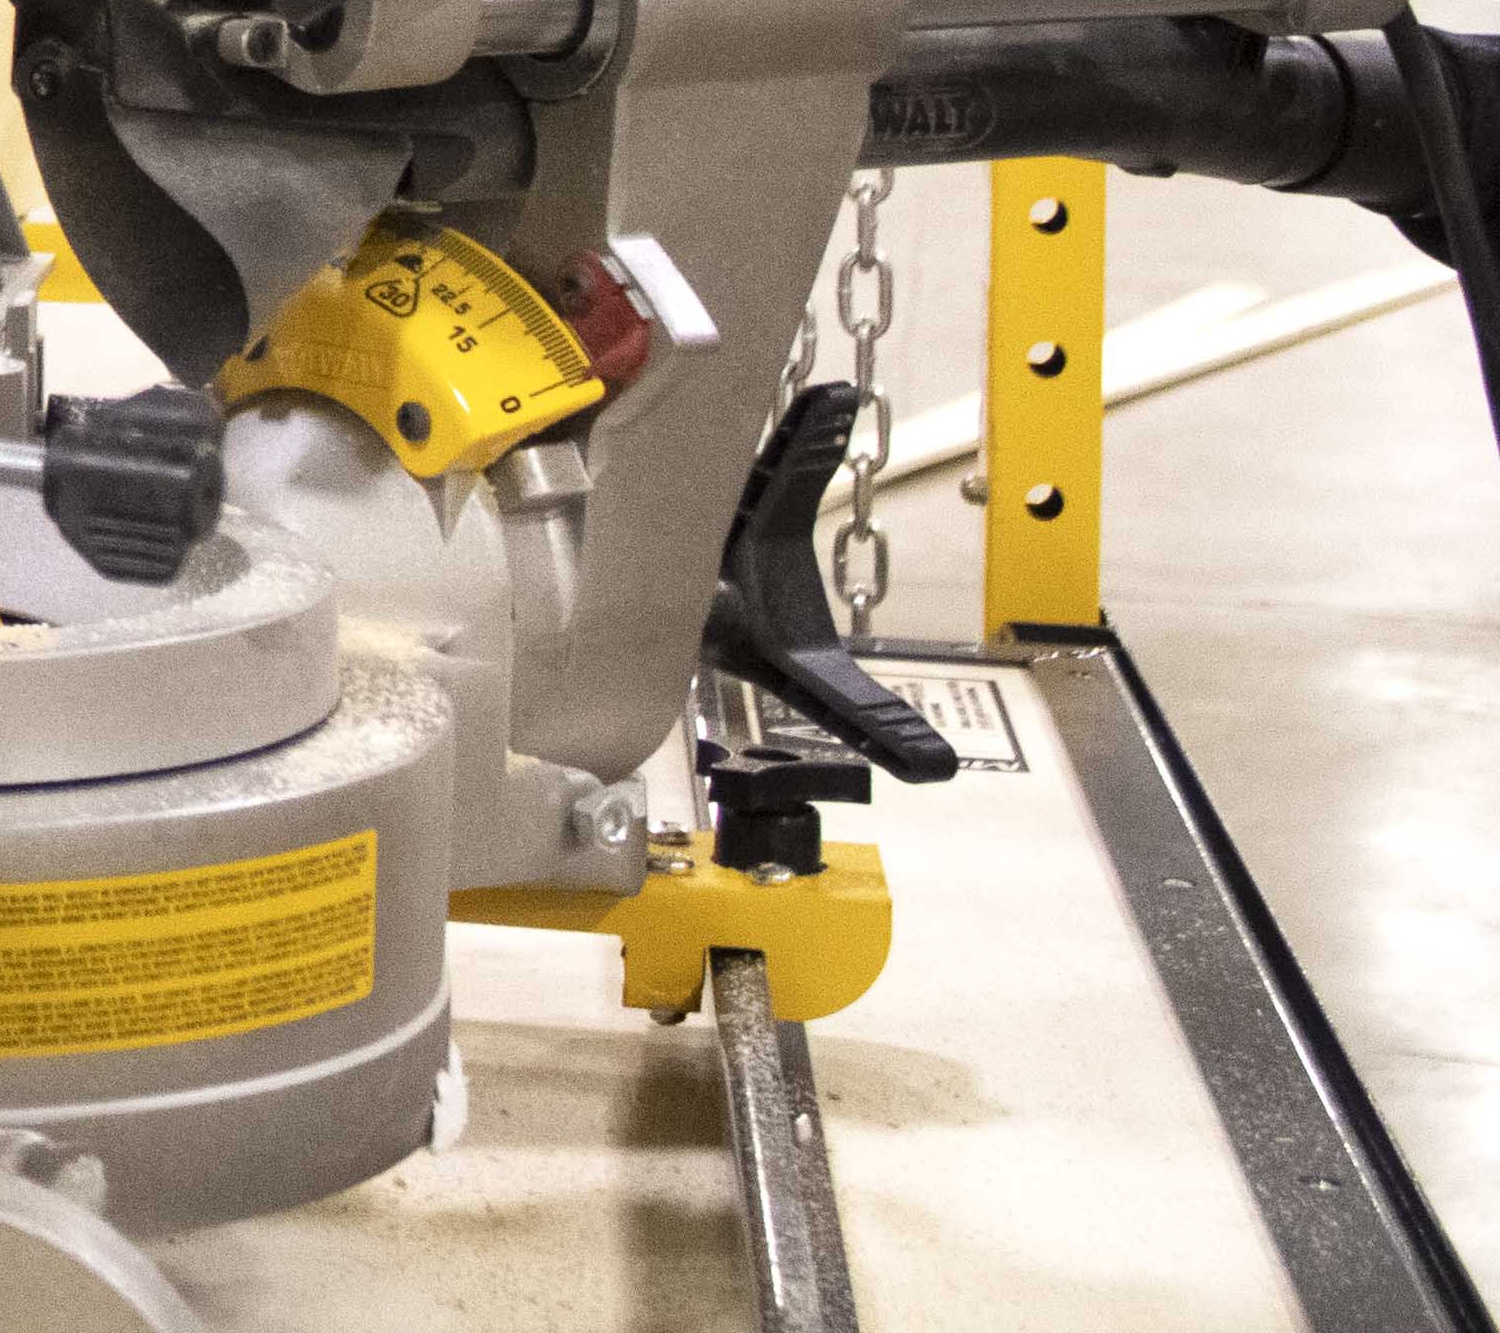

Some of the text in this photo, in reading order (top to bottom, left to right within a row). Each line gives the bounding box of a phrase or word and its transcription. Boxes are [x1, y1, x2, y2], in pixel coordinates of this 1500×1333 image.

[871, 94, 968, 137] WALT
[378, 284, 411, 308] 30
[431, 282, 473, 316] 22.5
[448, 324, 479, 354] 15
[499, 395, 522, 414] 0
